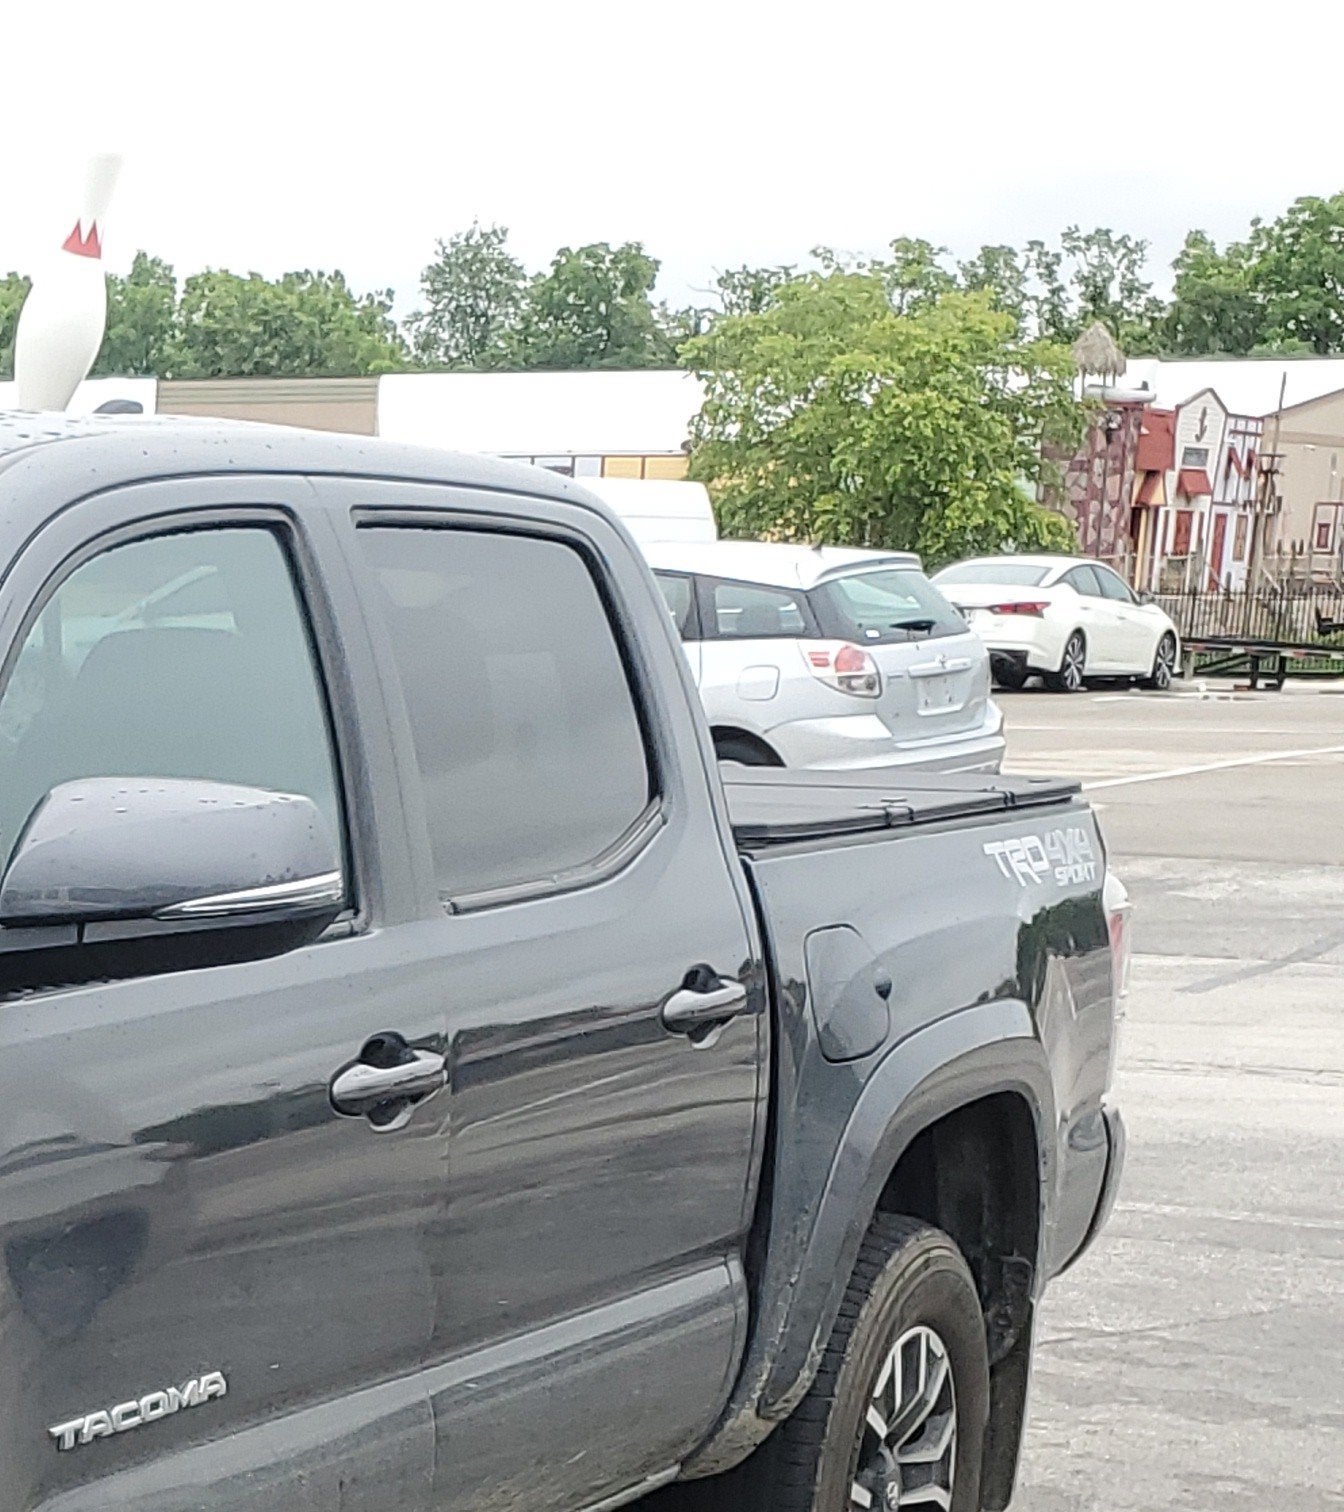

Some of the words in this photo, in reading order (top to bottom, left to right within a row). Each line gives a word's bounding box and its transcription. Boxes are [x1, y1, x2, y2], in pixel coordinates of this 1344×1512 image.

[983, 835, 1050, 887] TRD
[1054, 861, 1097, 887] SPORT
[48, 1370, 228, 1451] TACOMA
